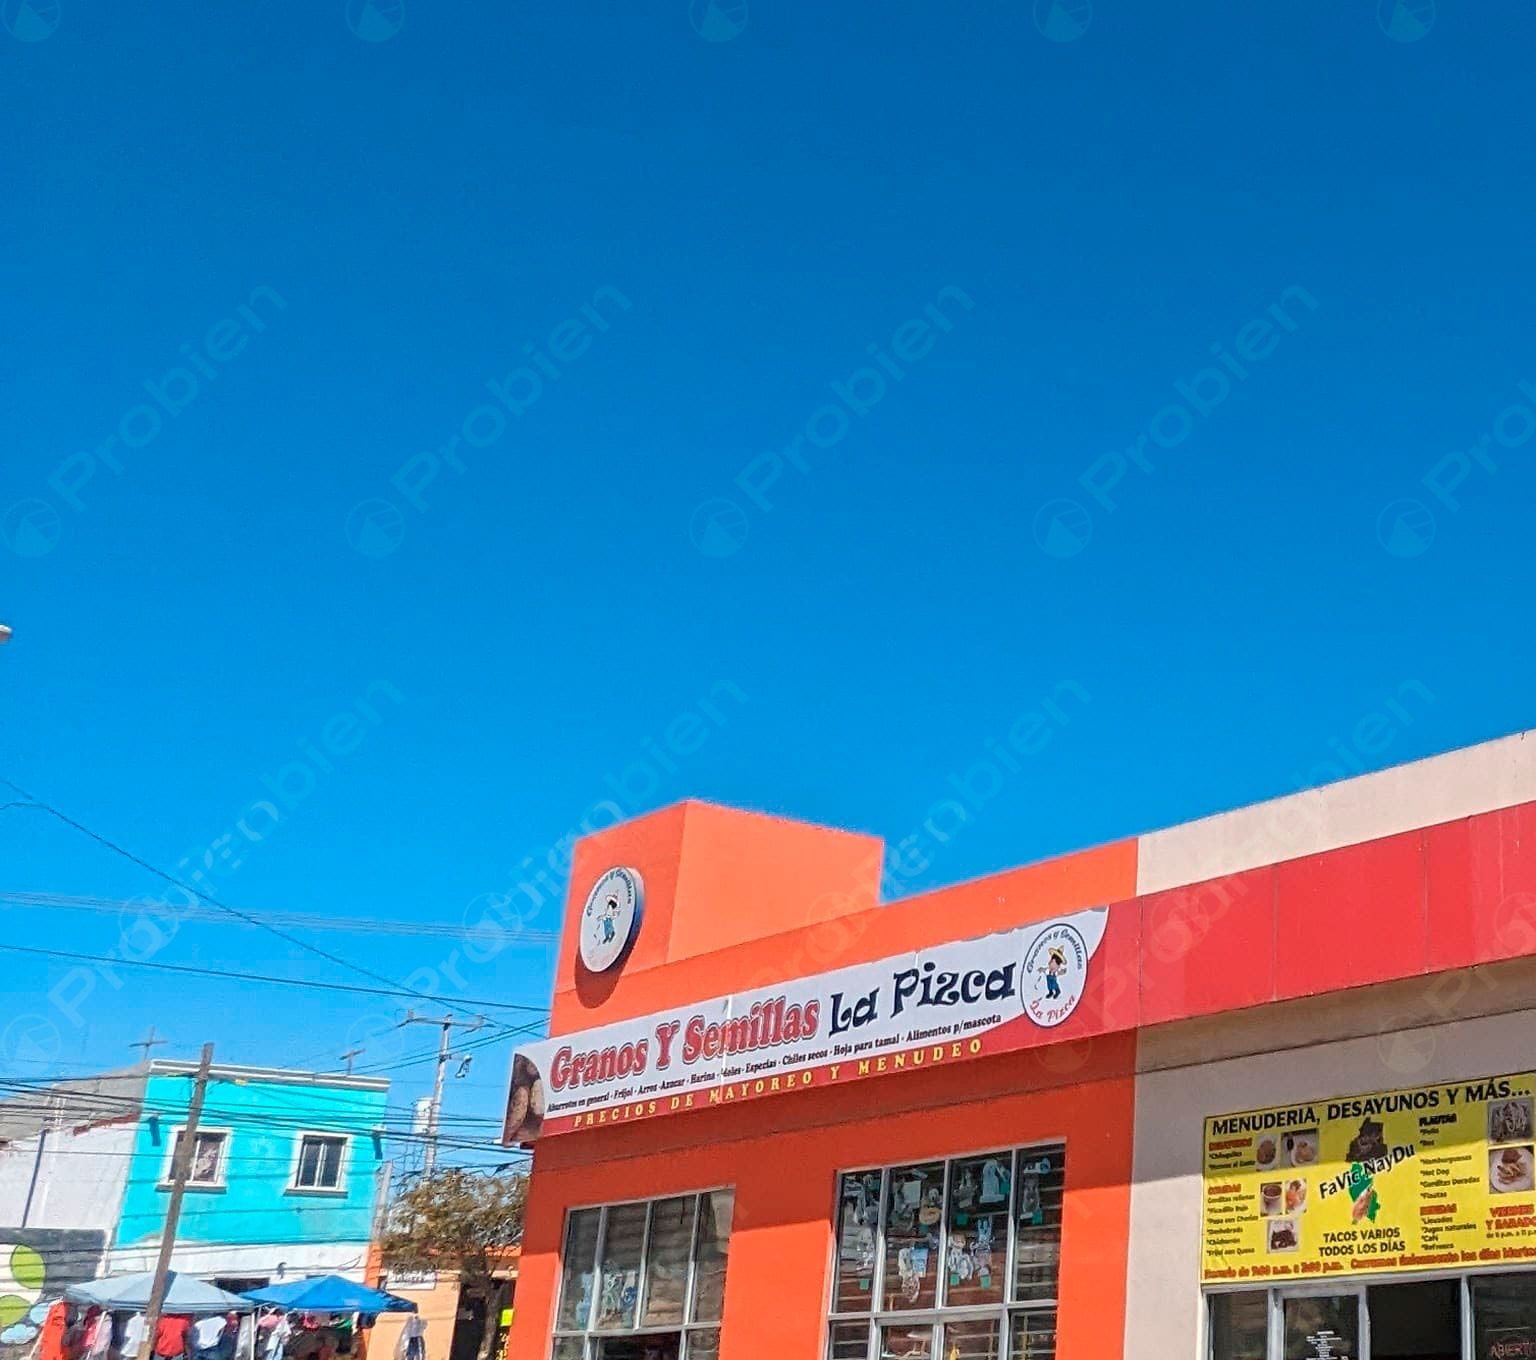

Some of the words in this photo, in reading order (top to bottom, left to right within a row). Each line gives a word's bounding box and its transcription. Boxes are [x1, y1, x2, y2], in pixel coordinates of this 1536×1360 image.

[551, 1038, 648, 1091] Granos
[655, 1021, 680, 1070] Y
[682, 995, 820, 1064] Semillas
[829, 987, 880, 1038] La
[891, 961, 1017, 1018] Pizca
[833, 1044, 853, 1057] Hoja
[854, 1041, 873, 1054] para
[875, 1033, 899, 1047] tamal
[905, 1024, 951, 1042] Alimentos
[952, 1014, 1002, 1035] p/mascota
[574, 1101, 656, 1127] PRECIOS
[671, 1094, 693, 1110] DE
[709, 1071, 812, 1104] MAYOREO
[830, 1066, 840, 1079] Y
[858, 1039, 982, 1076] MENUDEO
[1212, 1106, 1320, 1136] MENUDERIA,
[1327, 1090, 1439, 1120] DESAYUNOS
[1446, 1090, 1459, 1105] Y
[1465, 1078, 1530, 1103] MÁS...
[1363, 1142, 1415, 1175] NayDu
[1319, 1244, 1354, 1257] TODOS
[1357, 1242, 1377, 1254] LOS
[1379, 1239, 1406, 1252] DÍAS
[1323, 1231, 1357, 1243] TACOS
[1360, 1227, 1400, 1240] VARIOS
